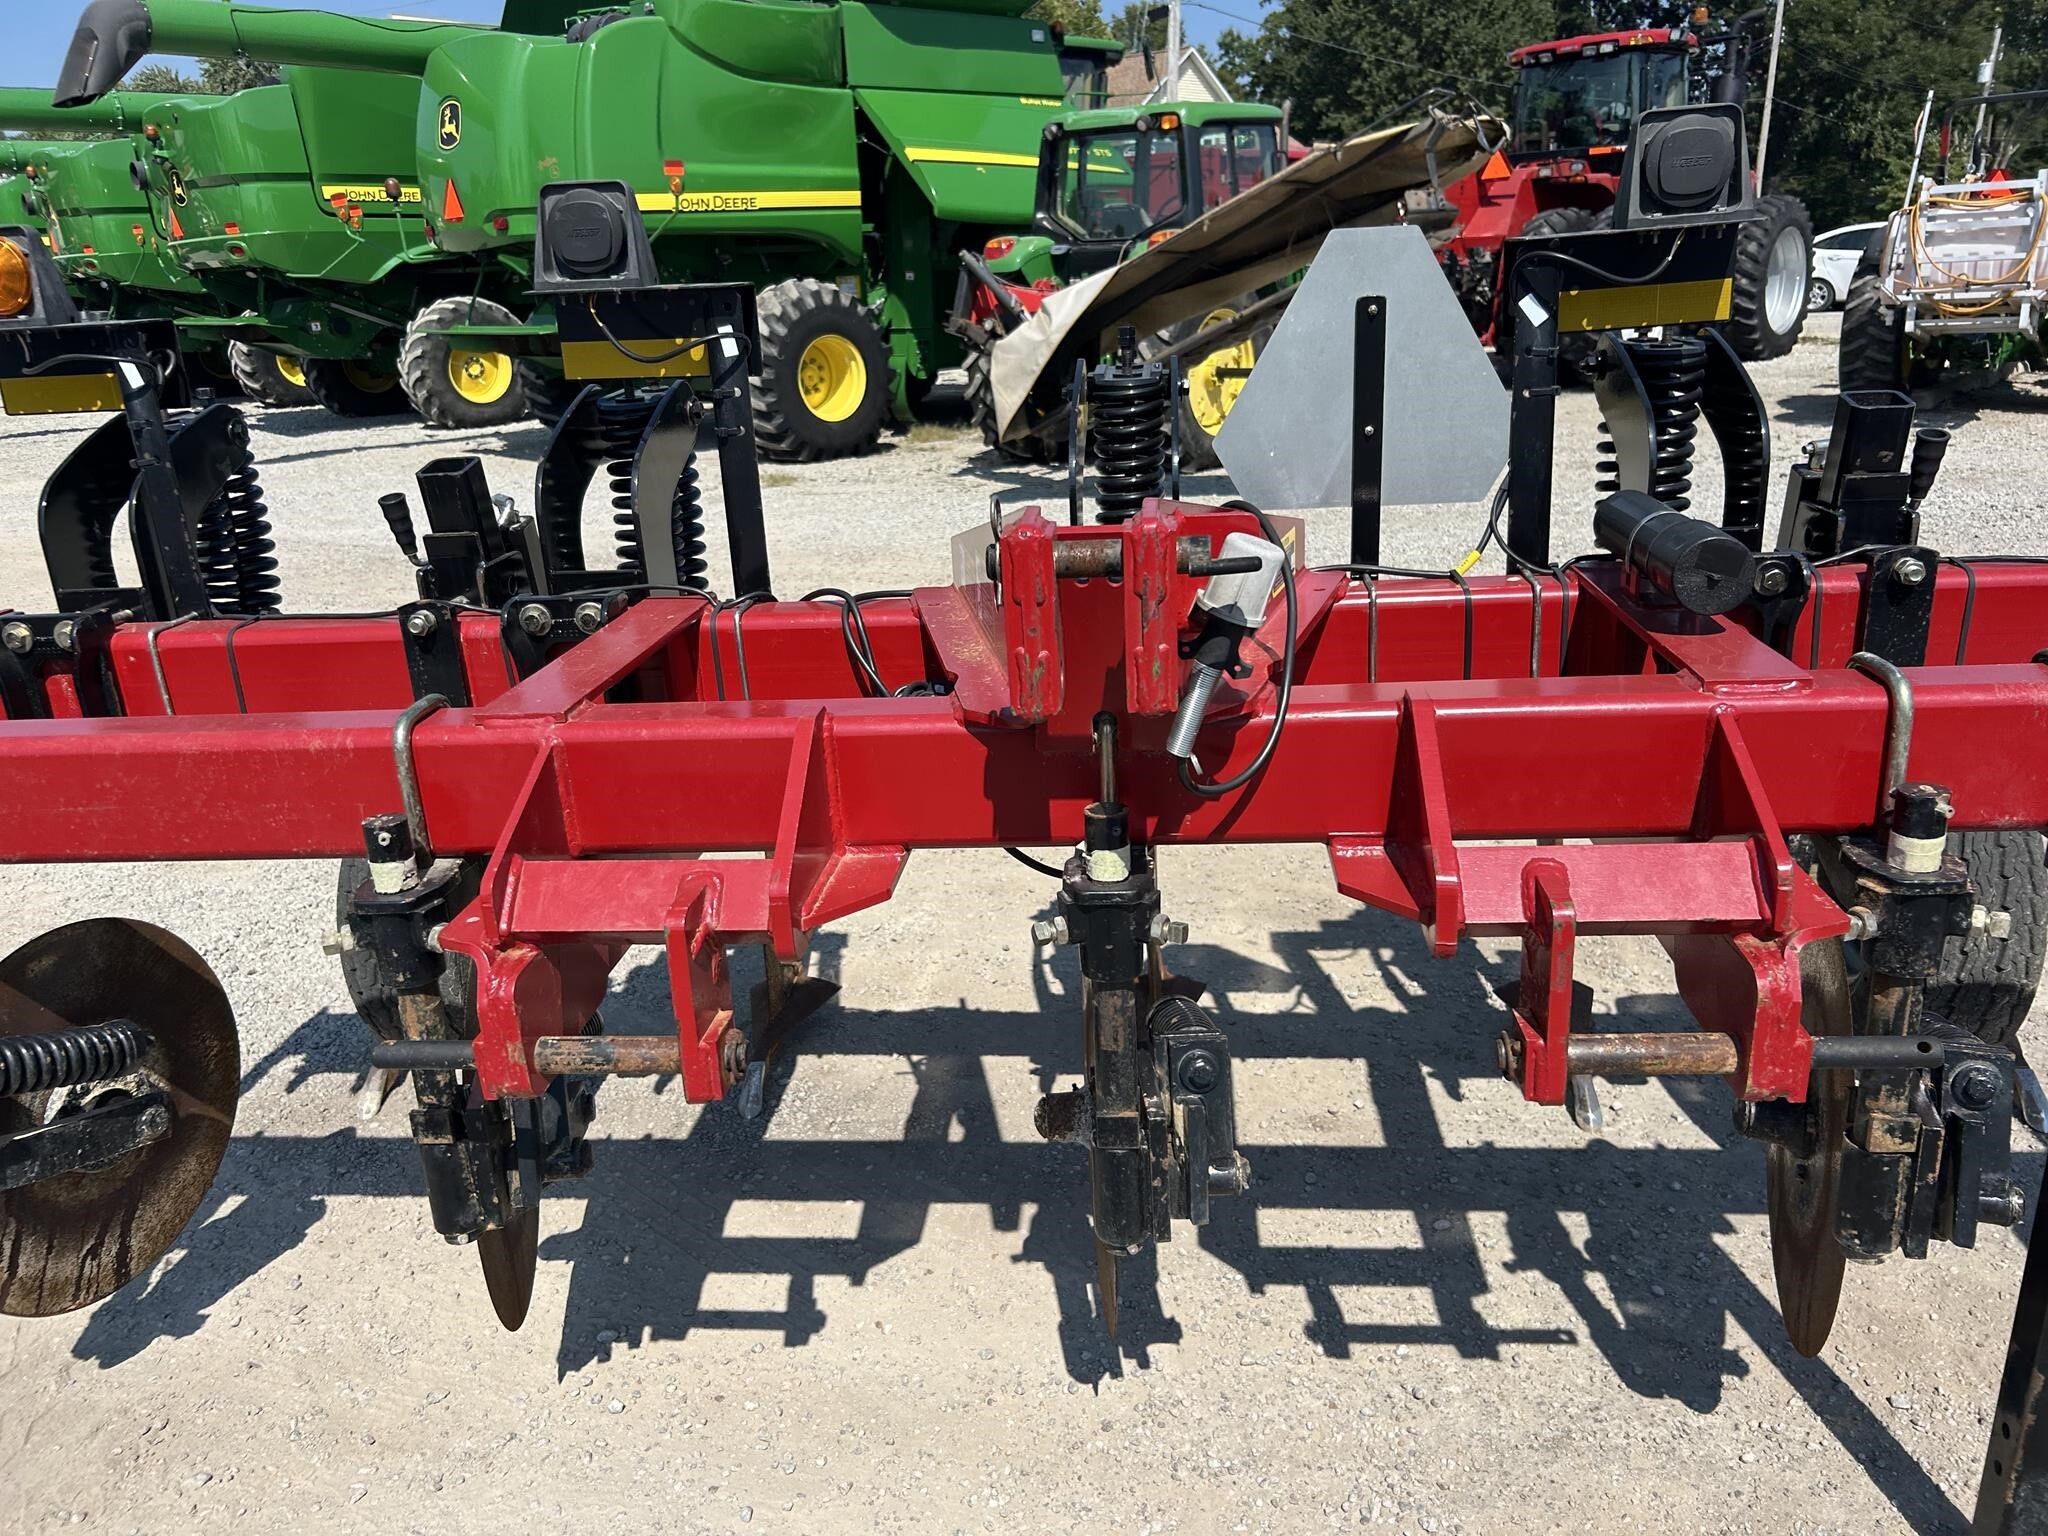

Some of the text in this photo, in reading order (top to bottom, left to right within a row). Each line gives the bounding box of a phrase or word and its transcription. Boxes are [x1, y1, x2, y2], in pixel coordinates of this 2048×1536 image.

[378, 189, 420, 201] DRE
[673, 195, 758, 210] OHN DEERE
